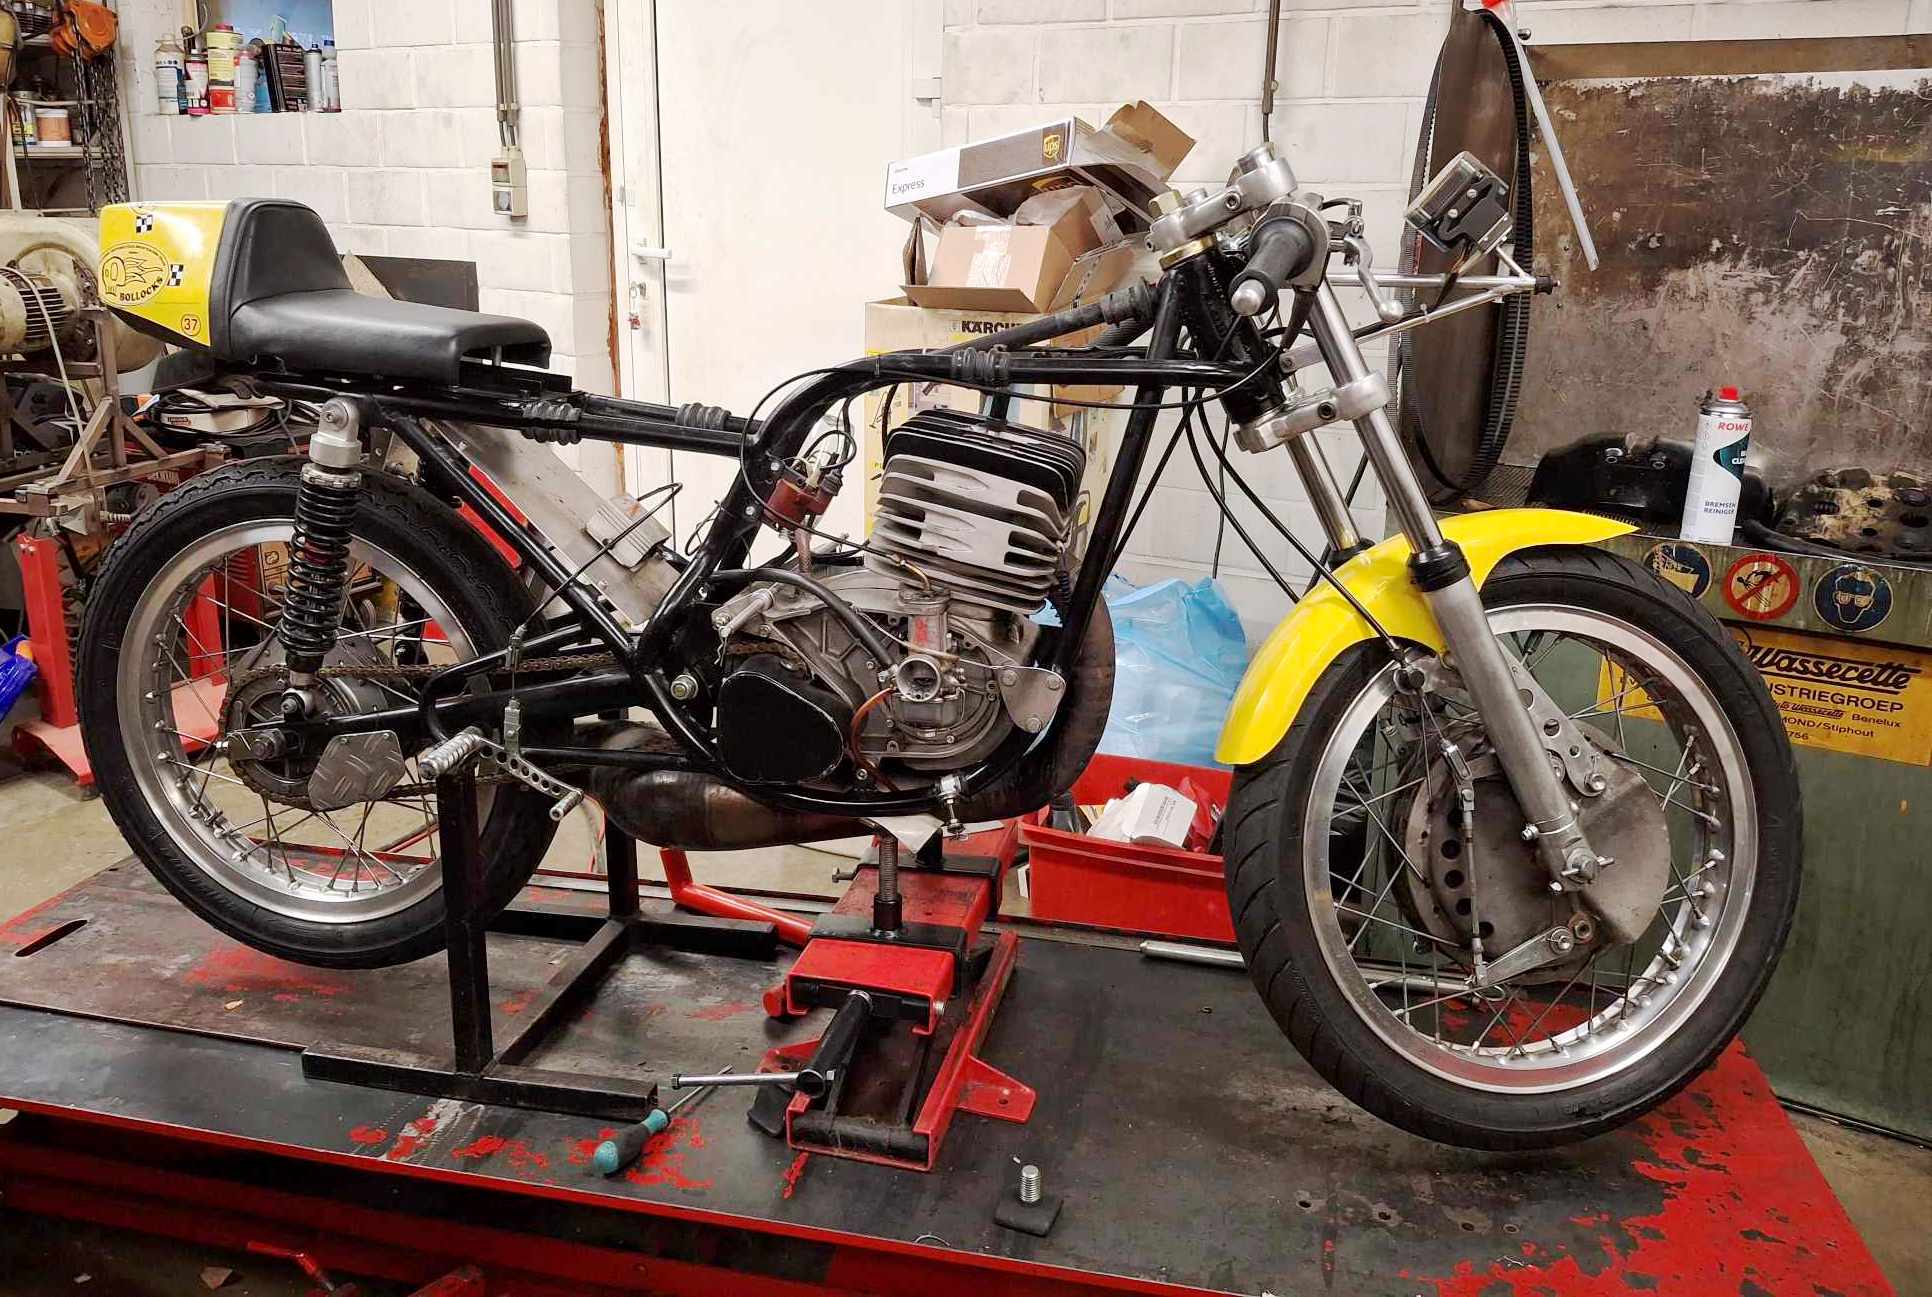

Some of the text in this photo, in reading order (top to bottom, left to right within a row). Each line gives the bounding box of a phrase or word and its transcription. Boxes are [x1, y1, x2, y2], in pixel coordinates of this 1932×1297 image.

[892, 178, 925, 195] Express
[183, 318, 198, 330] 37
[1852, 713, 1902, 728] Benelux
